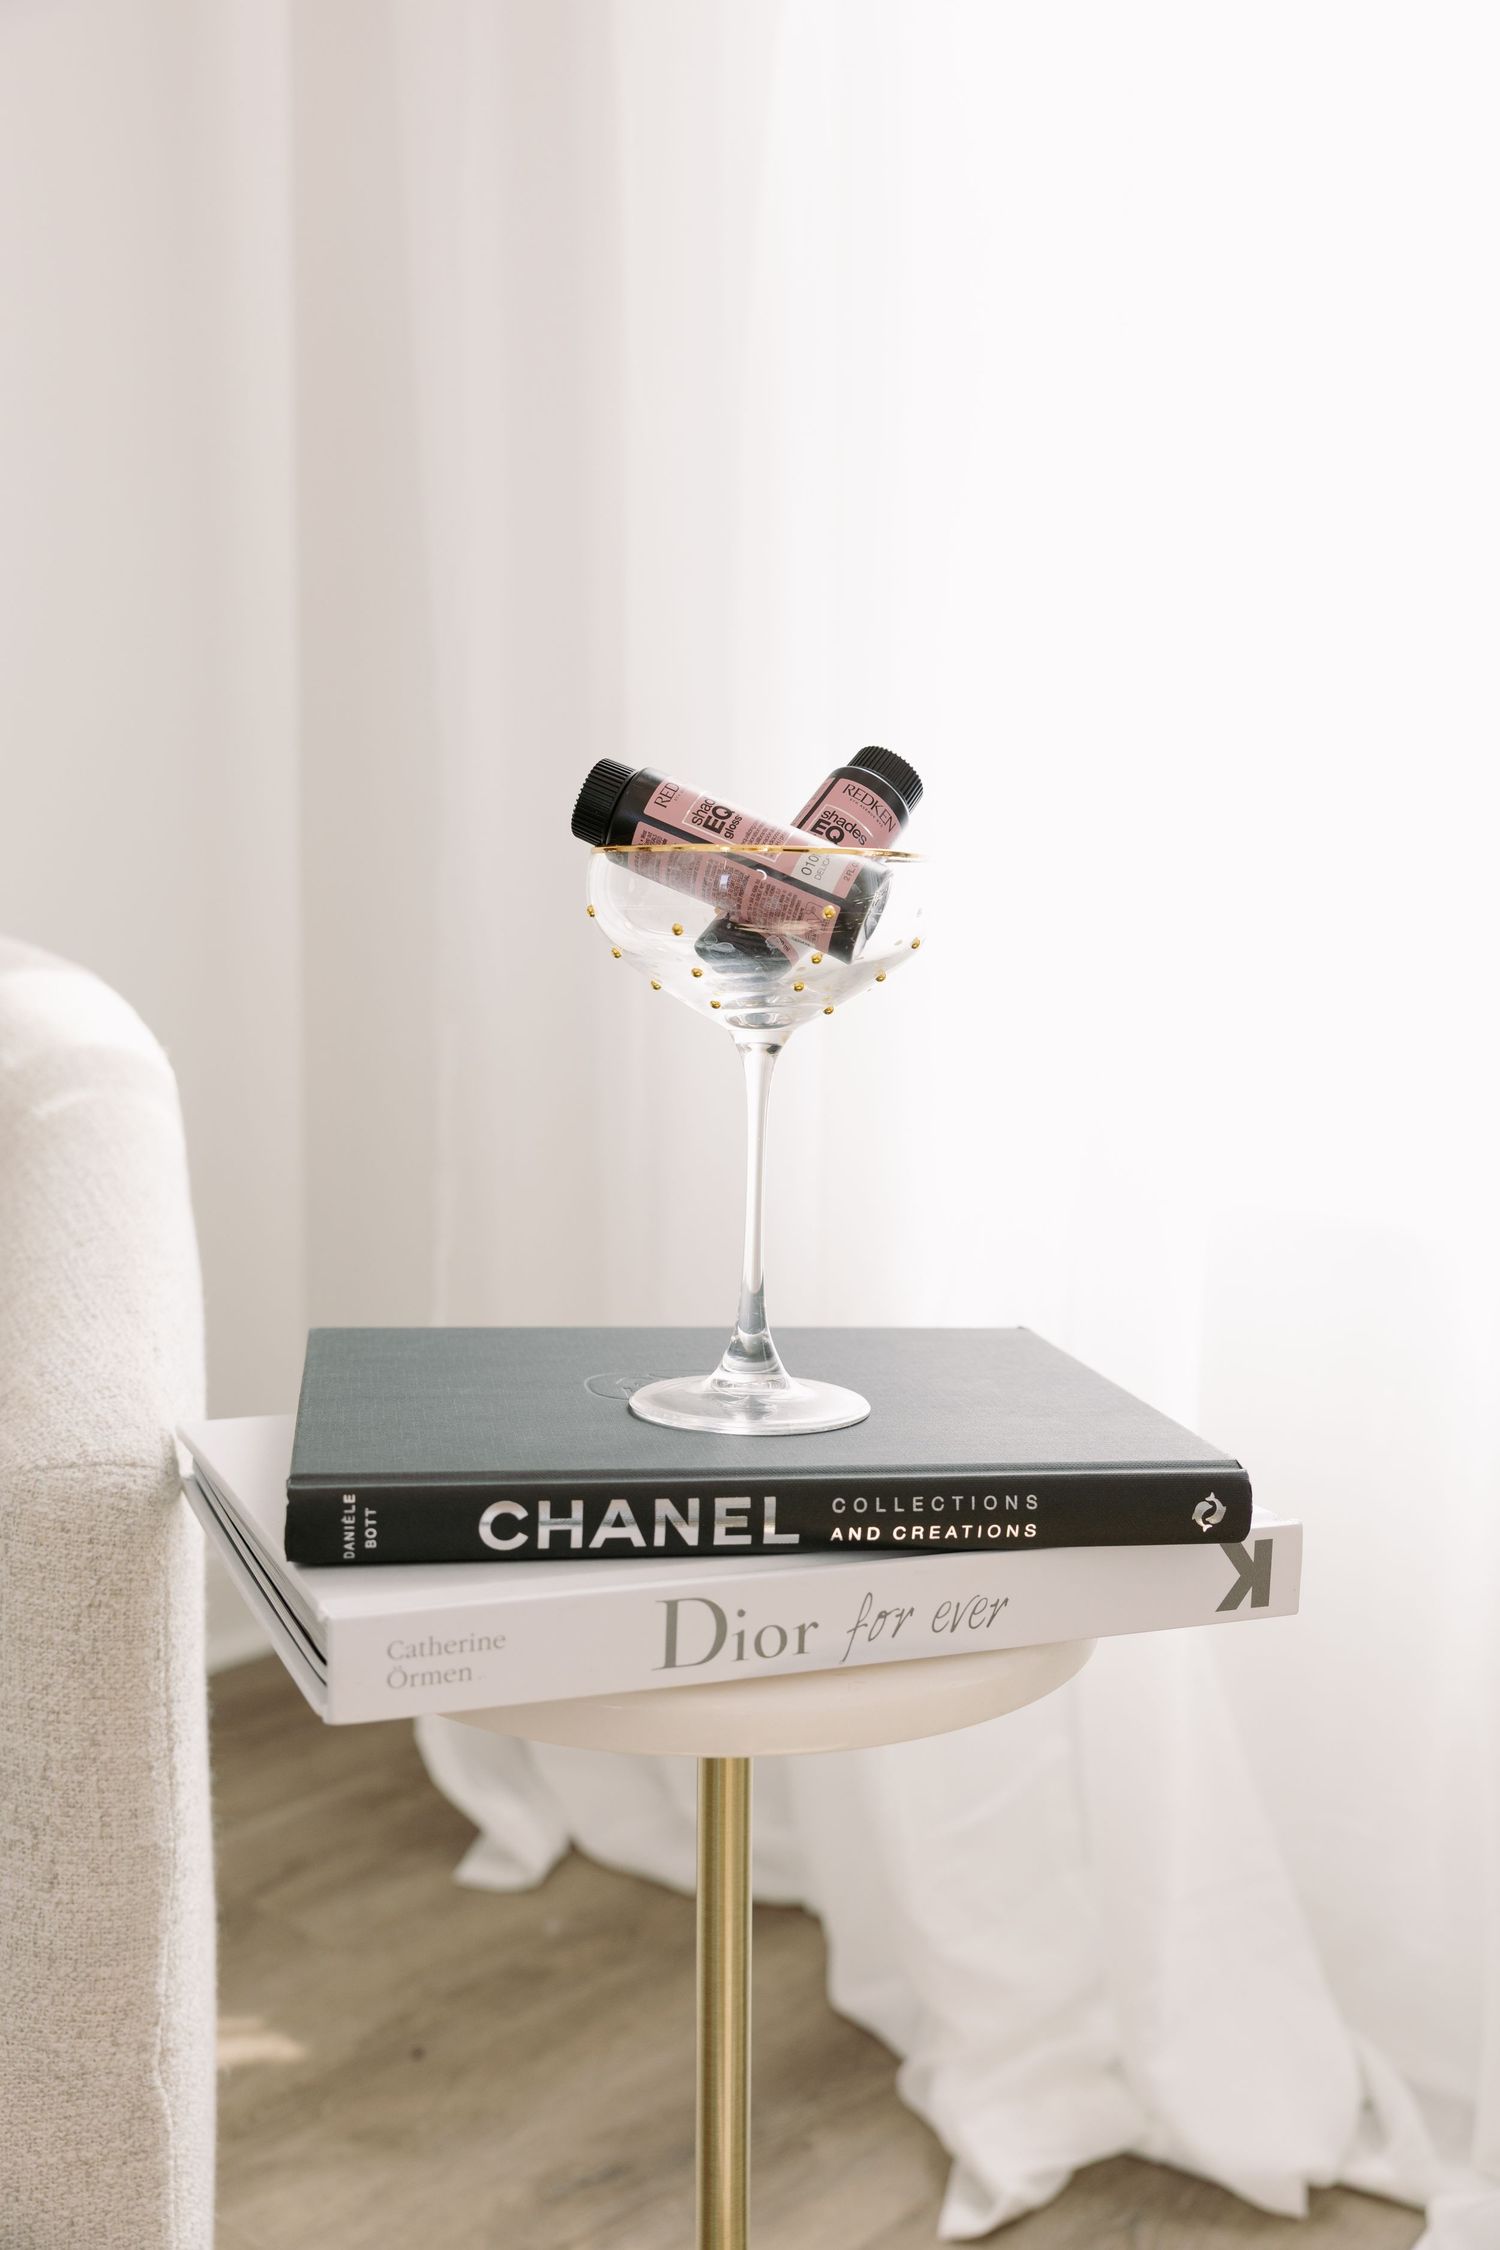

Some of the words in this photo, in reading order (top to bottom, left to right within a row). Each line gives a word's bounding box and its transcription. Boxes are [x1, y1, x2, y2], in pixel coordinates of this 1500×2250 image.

[702, 805, 735, 834] EQ
[842, 783, 897, 833] REDKEN
[724, 815, 742, 839] gloss
[810, 819, 845, 845] EQ
[821, 810, 867, 846] shades
[832, 1494, 1039, 1513] COLLECTIONS
[343, 1493, 356, 1560] DANIÈLE
[365, 1507, 377, 1549] BOTT
[479, 1496, 800, 1551] CHANEL
[831, 1525, 881, 1542] AND
[892, 1523, 1038, 1541] CREATIONS
[651, 1597, 819, 1672] Dior
[841, 1591, 915, 1664] for
[931, 1593, 1009, 1633] ever
[387, 1632, 506, 1662] Catherine
[387, 1664, 472, 1690] Örmen
